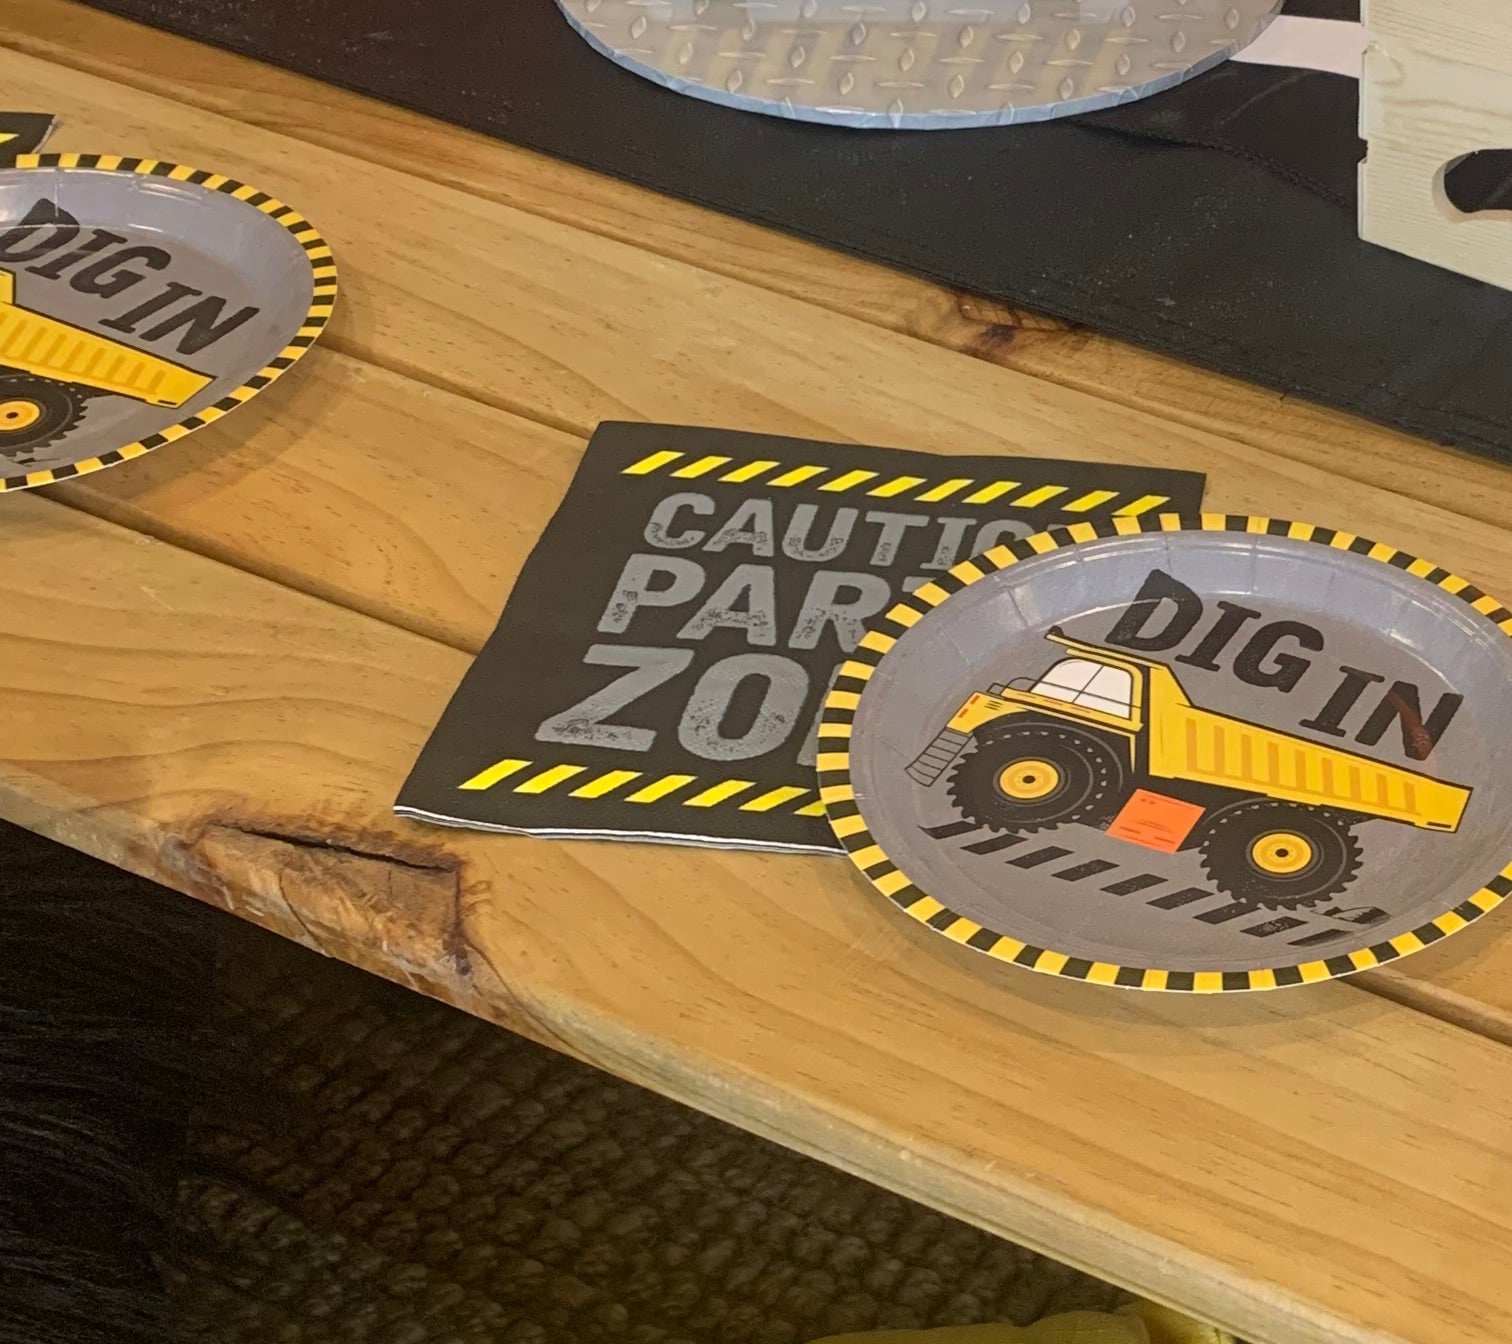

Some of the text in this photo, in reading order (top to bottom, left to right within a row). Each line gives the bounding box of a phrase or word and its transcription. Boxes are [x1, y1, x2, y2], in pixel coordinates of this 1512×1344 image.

[0, 198, 260, 356] DIG IN
[643, 492, 1067, 570] CAUTI
[597, 553, 936, 653] PAR
[1105, 568, 1464, 761] DIG IN
[535, 644, 842, 767] ZO
